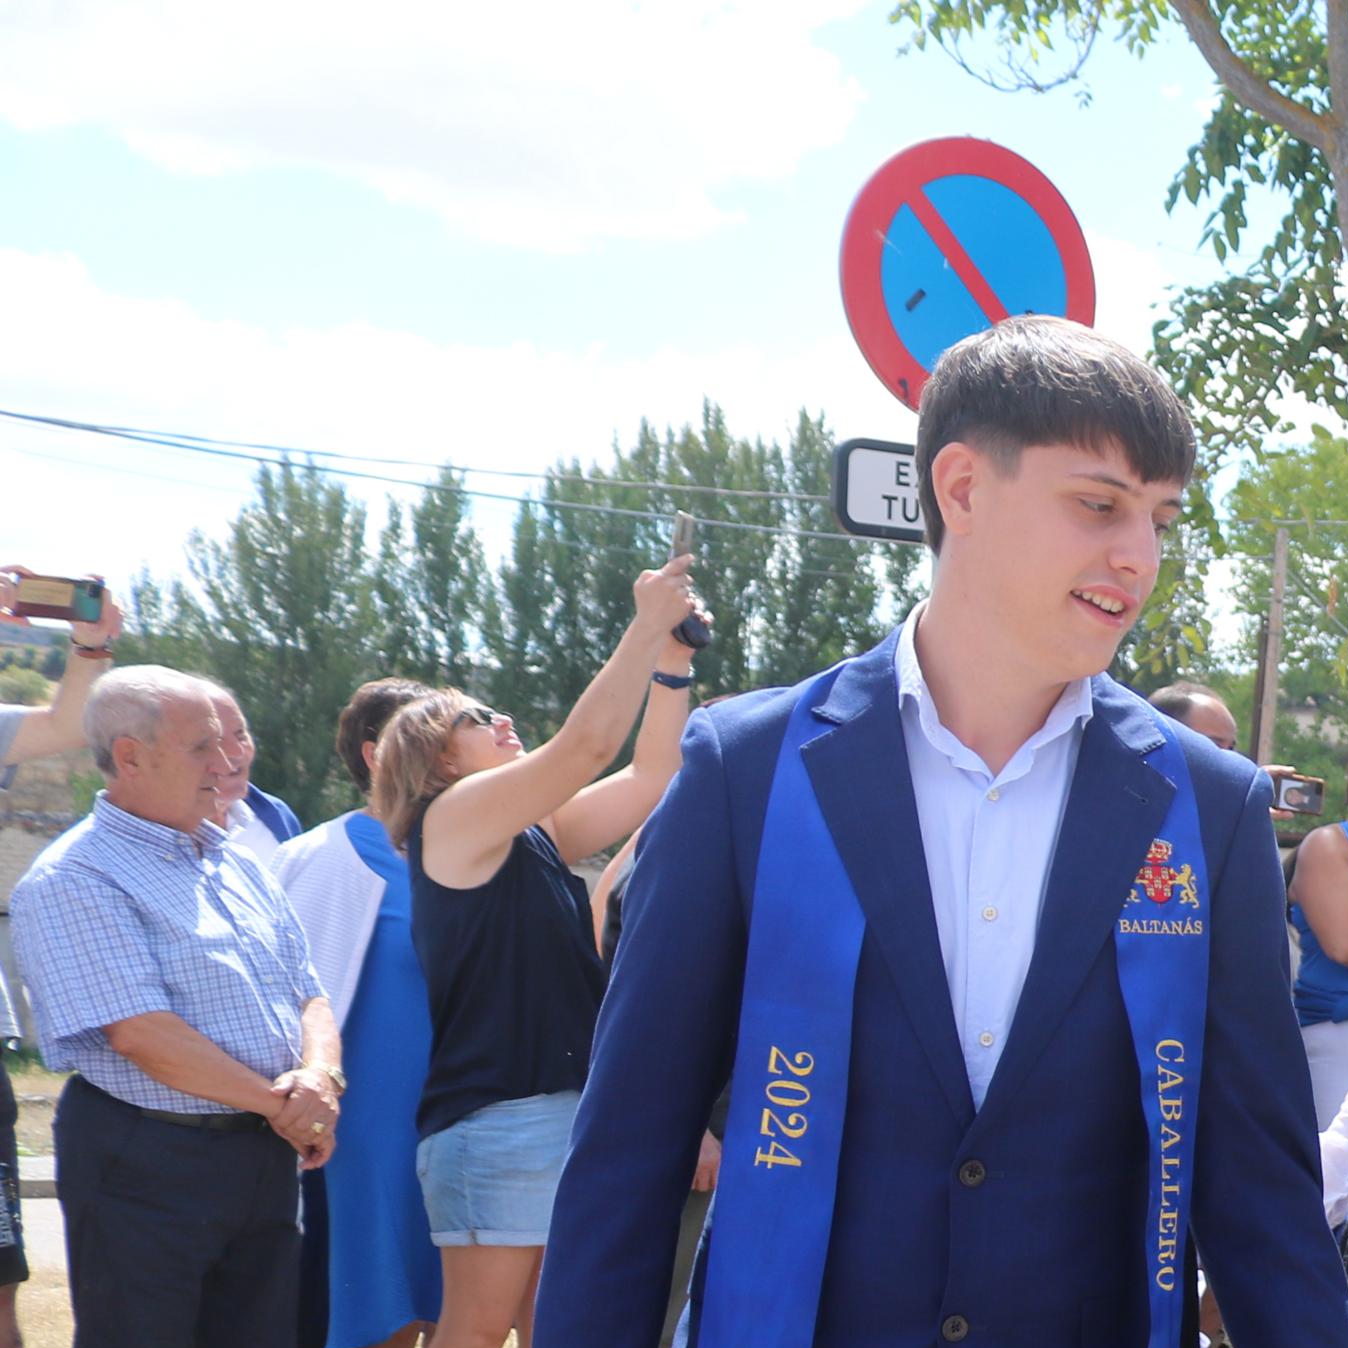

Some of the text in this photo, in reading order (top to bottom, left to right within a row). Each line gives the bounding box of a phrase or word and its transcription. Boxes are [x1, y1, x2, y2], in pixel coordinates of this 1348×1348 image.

[1118, 916, 1203, 936] BALTANÁS
[754, 1045, 815, 1169] 2024
[1155, 1039, 1185, 1292] CABALLERO
